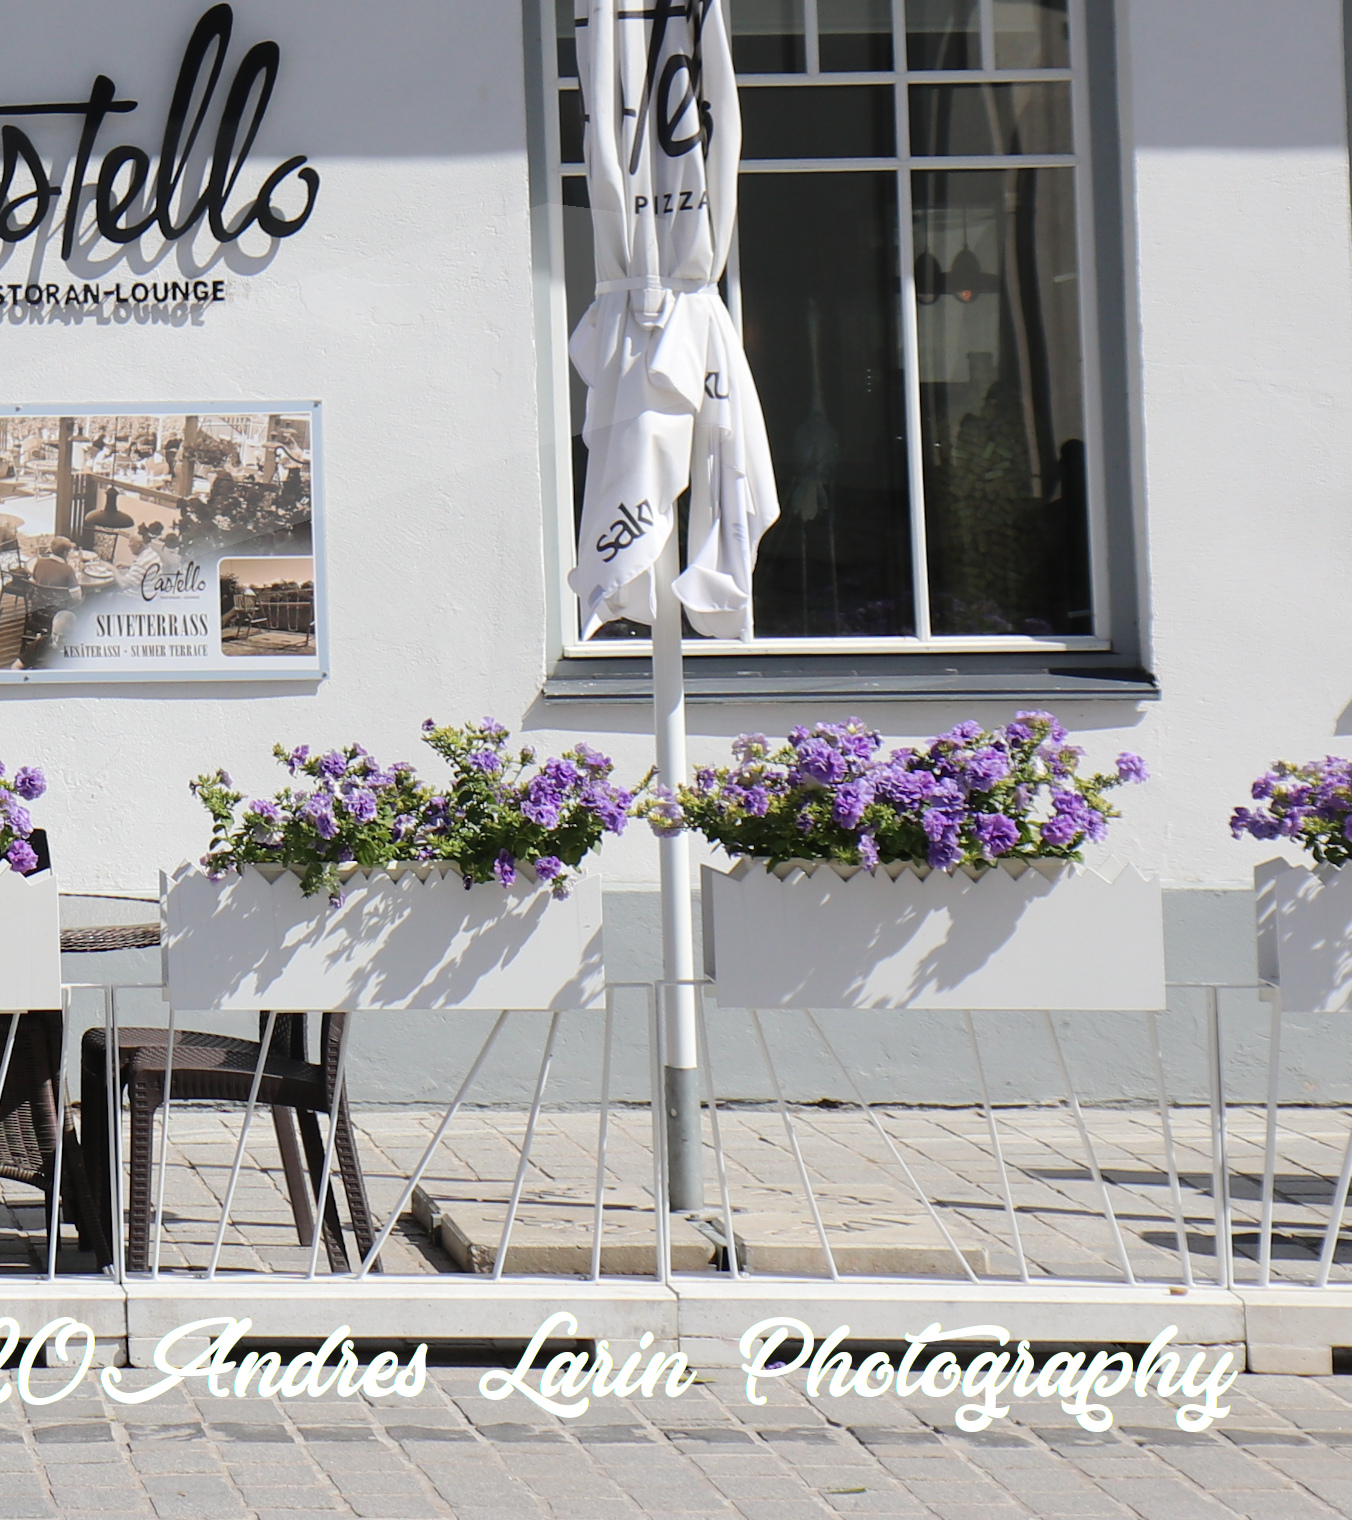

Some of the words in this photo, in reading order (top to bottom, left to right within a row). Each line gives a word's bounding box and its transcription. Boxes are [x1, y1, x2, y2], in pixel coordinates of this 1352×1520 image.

[596, 498, 654, 564] sak
[140, 560, 207, 602] Castello
[95, 613, 209, 638] SUVETERRASS
[63, 643, 121, 658] KESÄTERASSI
[130, 645, 167, 658] SUMMER
[168, 644, 208, 657] TERRACE
